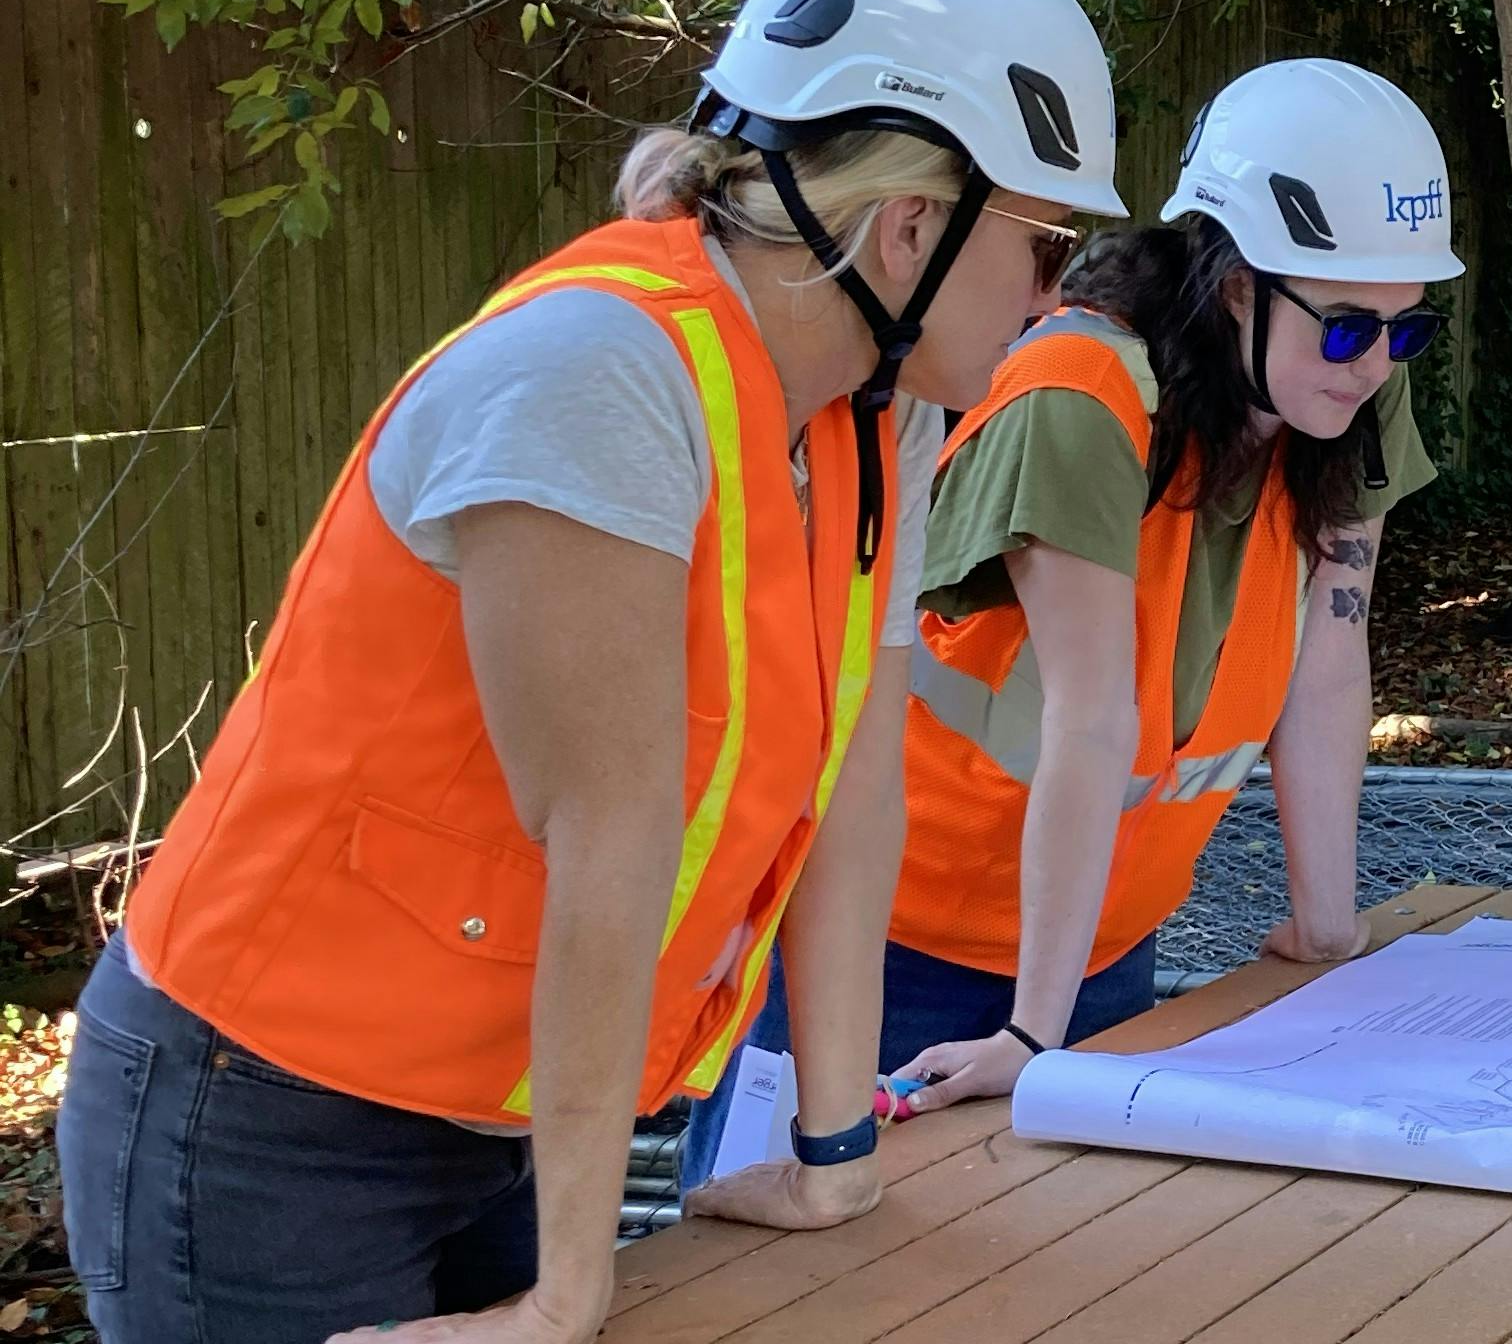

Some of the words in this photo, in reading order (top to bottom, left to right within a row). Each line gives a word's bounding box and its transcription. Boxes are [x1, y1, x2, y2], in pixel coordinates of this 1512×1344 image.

[901, 82, 946, 101] Bullard
[1382, 177, 1442, 232] kpff
[752, 1076, 777, 1090] rger
